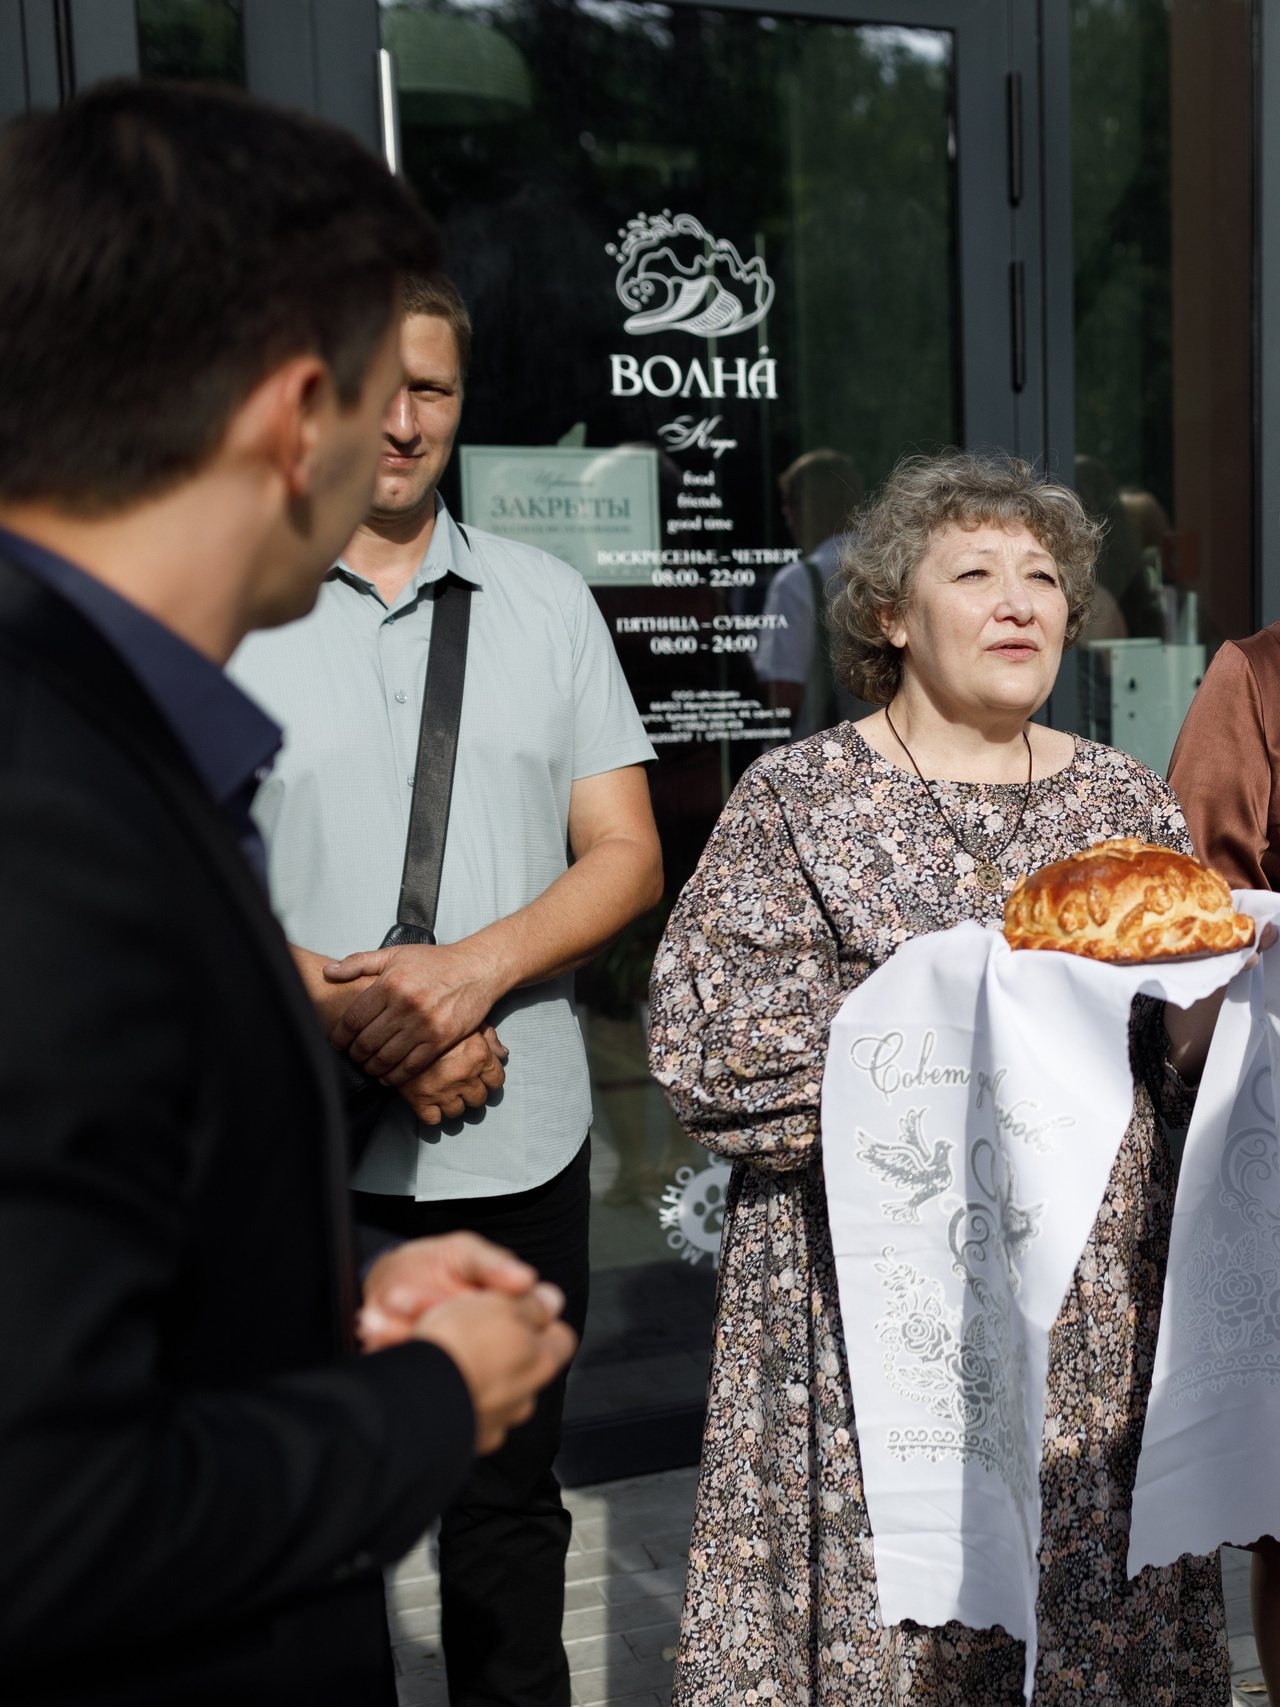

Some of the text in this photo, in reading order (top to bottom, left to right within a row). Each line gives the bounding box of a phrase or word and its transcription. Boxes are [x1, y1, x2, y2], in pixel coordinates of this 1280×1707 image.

[682, 469, 715, 486] food
[490, 495, 631, 519] ЗАКРЫТЫ
[677, 492, 723, 509] friends
[667, 515, 734, 535] good time
[597, 549, 719, 566] ВОСКРЕСЕНЬЕ
[732, 548, 803, 565] ЧЕТВЕРГ
[709, 568, 756, 587] 22:00
[616, 615, 700, 633] ПЯТНИЦА
[712, 613, 789, 631] СУББОТА
[650, 636, 698, 654] 08:00
[711, 634, 758, 653] 24:00
[851, 1031, 970, 1103] Совет
